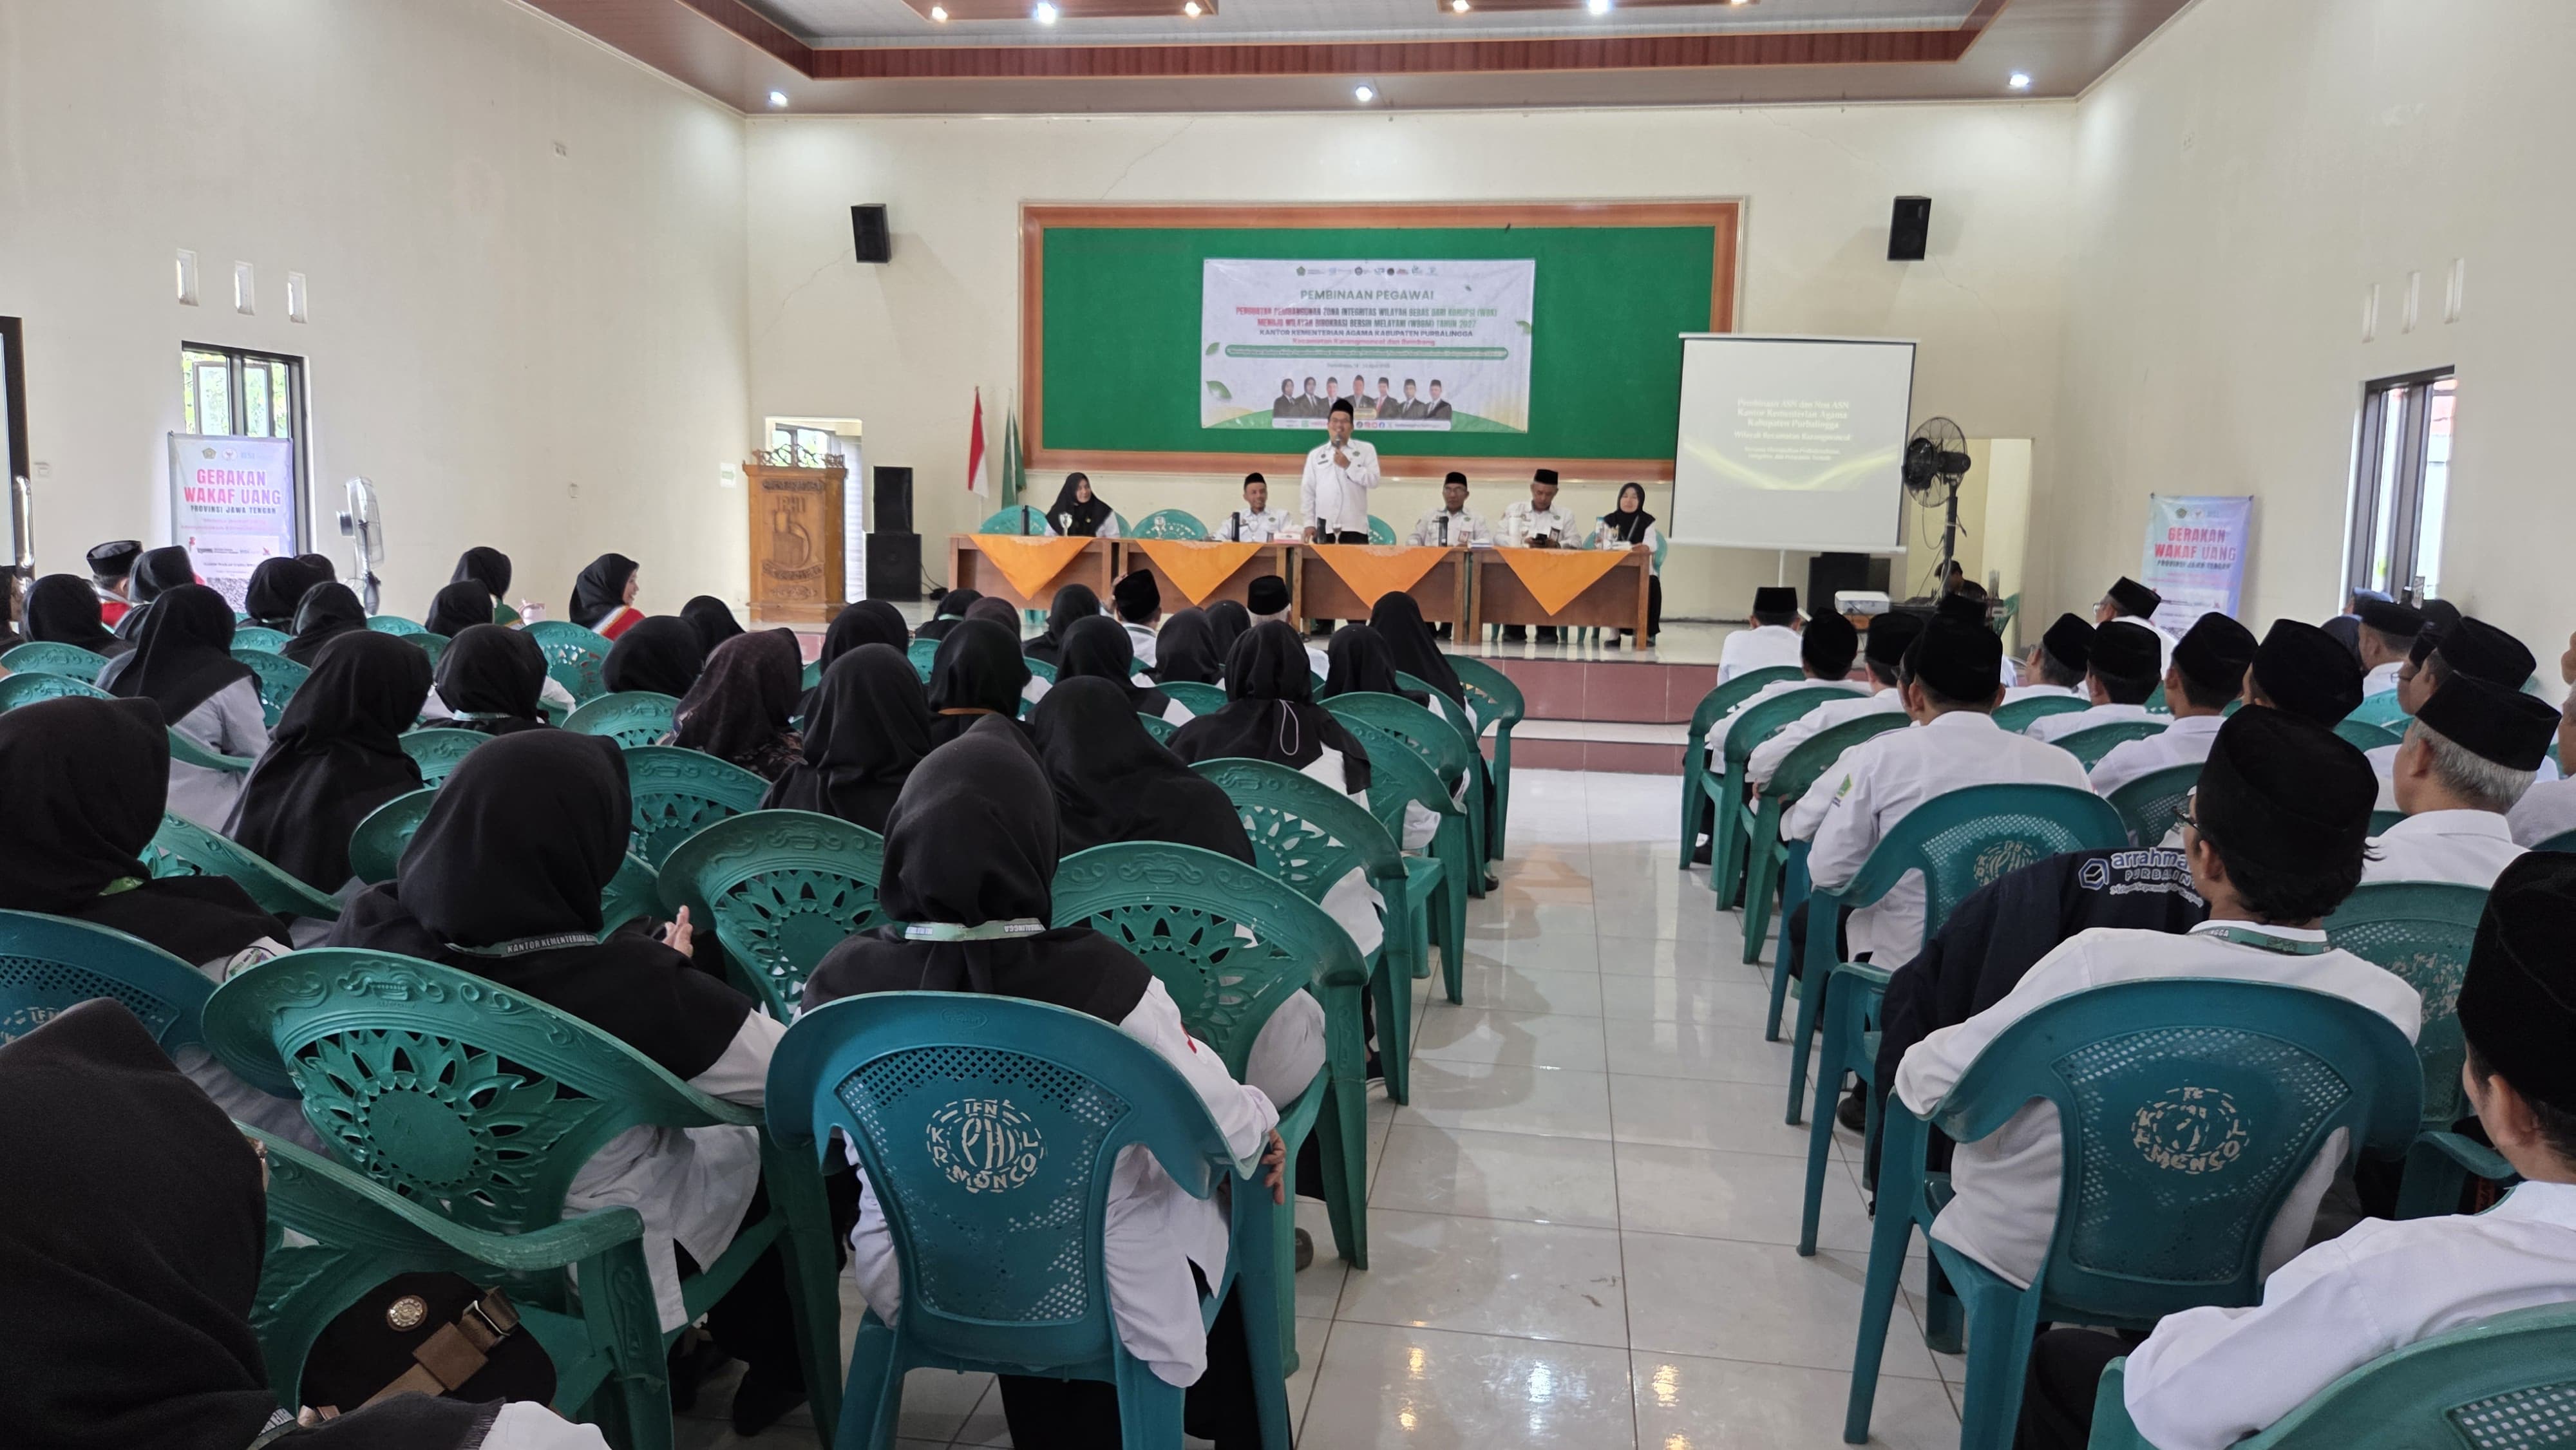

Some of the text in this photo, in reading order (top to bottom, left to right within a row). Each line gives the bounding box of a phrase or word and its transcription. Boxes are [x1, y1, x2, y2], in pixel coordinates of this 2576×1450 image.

[1300, 290, 1434, 301] PEMBINAAN PEGAWAI
[1323, 308, 1340, 316] ZONA
[1341, 308, 1376, 316] INTEGRITAS
[1378, 308, 1407, 316] WILAYAH
[196, 469, 266, 486] GERAKAN
[184, 486, 281, 505] WAKAF UANG
[191, 505, 223, 513] PROVINSI
[2168, 527, 2226, 543] GERAKAN
[2154, 543, 2237, 561] WAKAF UANG
[2110, 847, 2192, 872] arrahma
[507, 939, 540, 954] KANTOR
